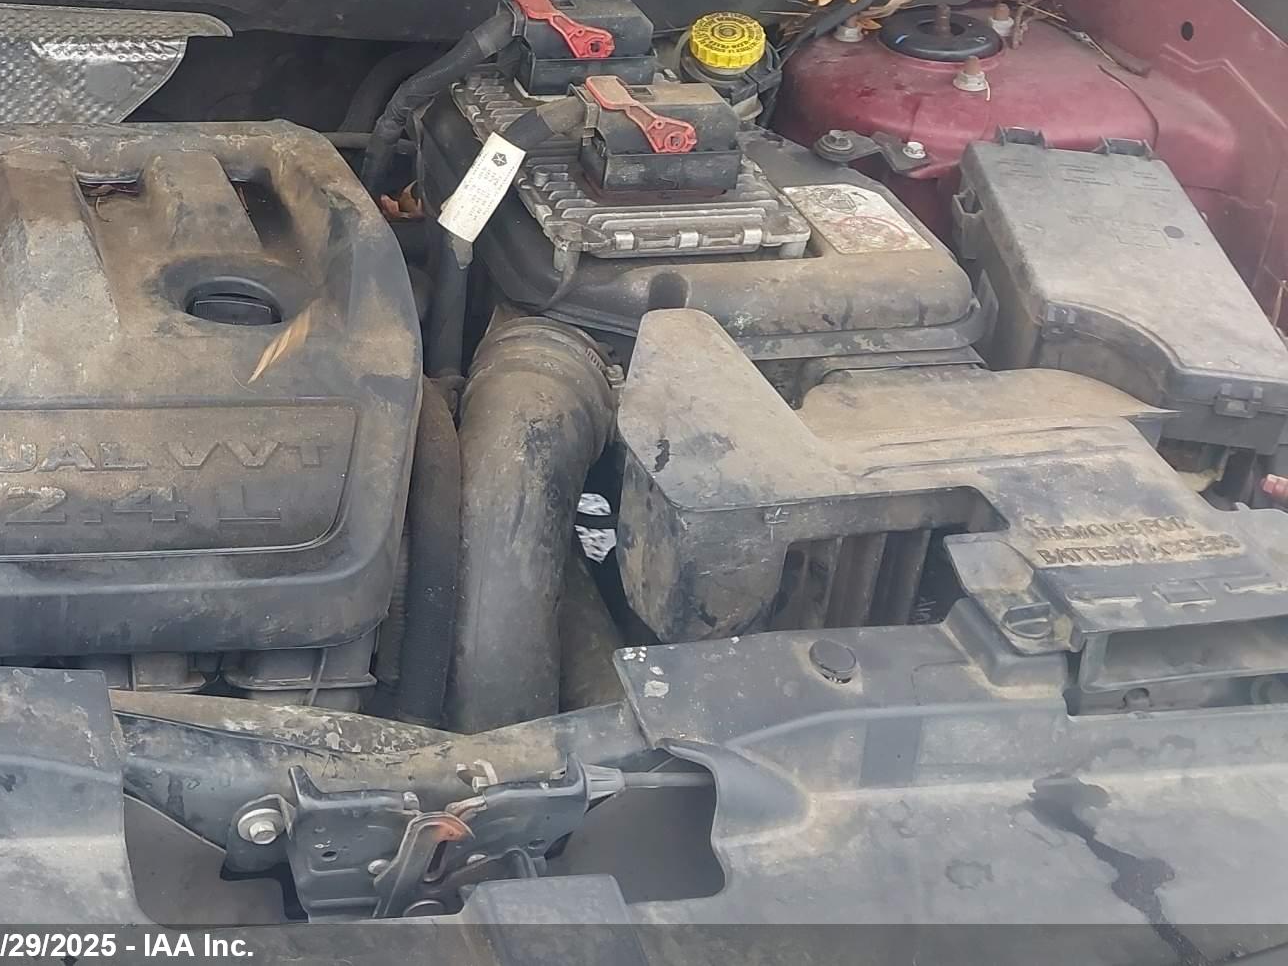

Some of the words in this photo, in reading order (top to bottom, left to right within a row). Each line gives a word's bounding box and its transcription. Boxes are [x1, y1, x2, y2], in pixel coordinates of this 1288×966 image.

[167, 438, 334, 470] VVT
[5, 484, 282, 527] 2.4L
[1037, 543, 1140, 565] BATTERY
